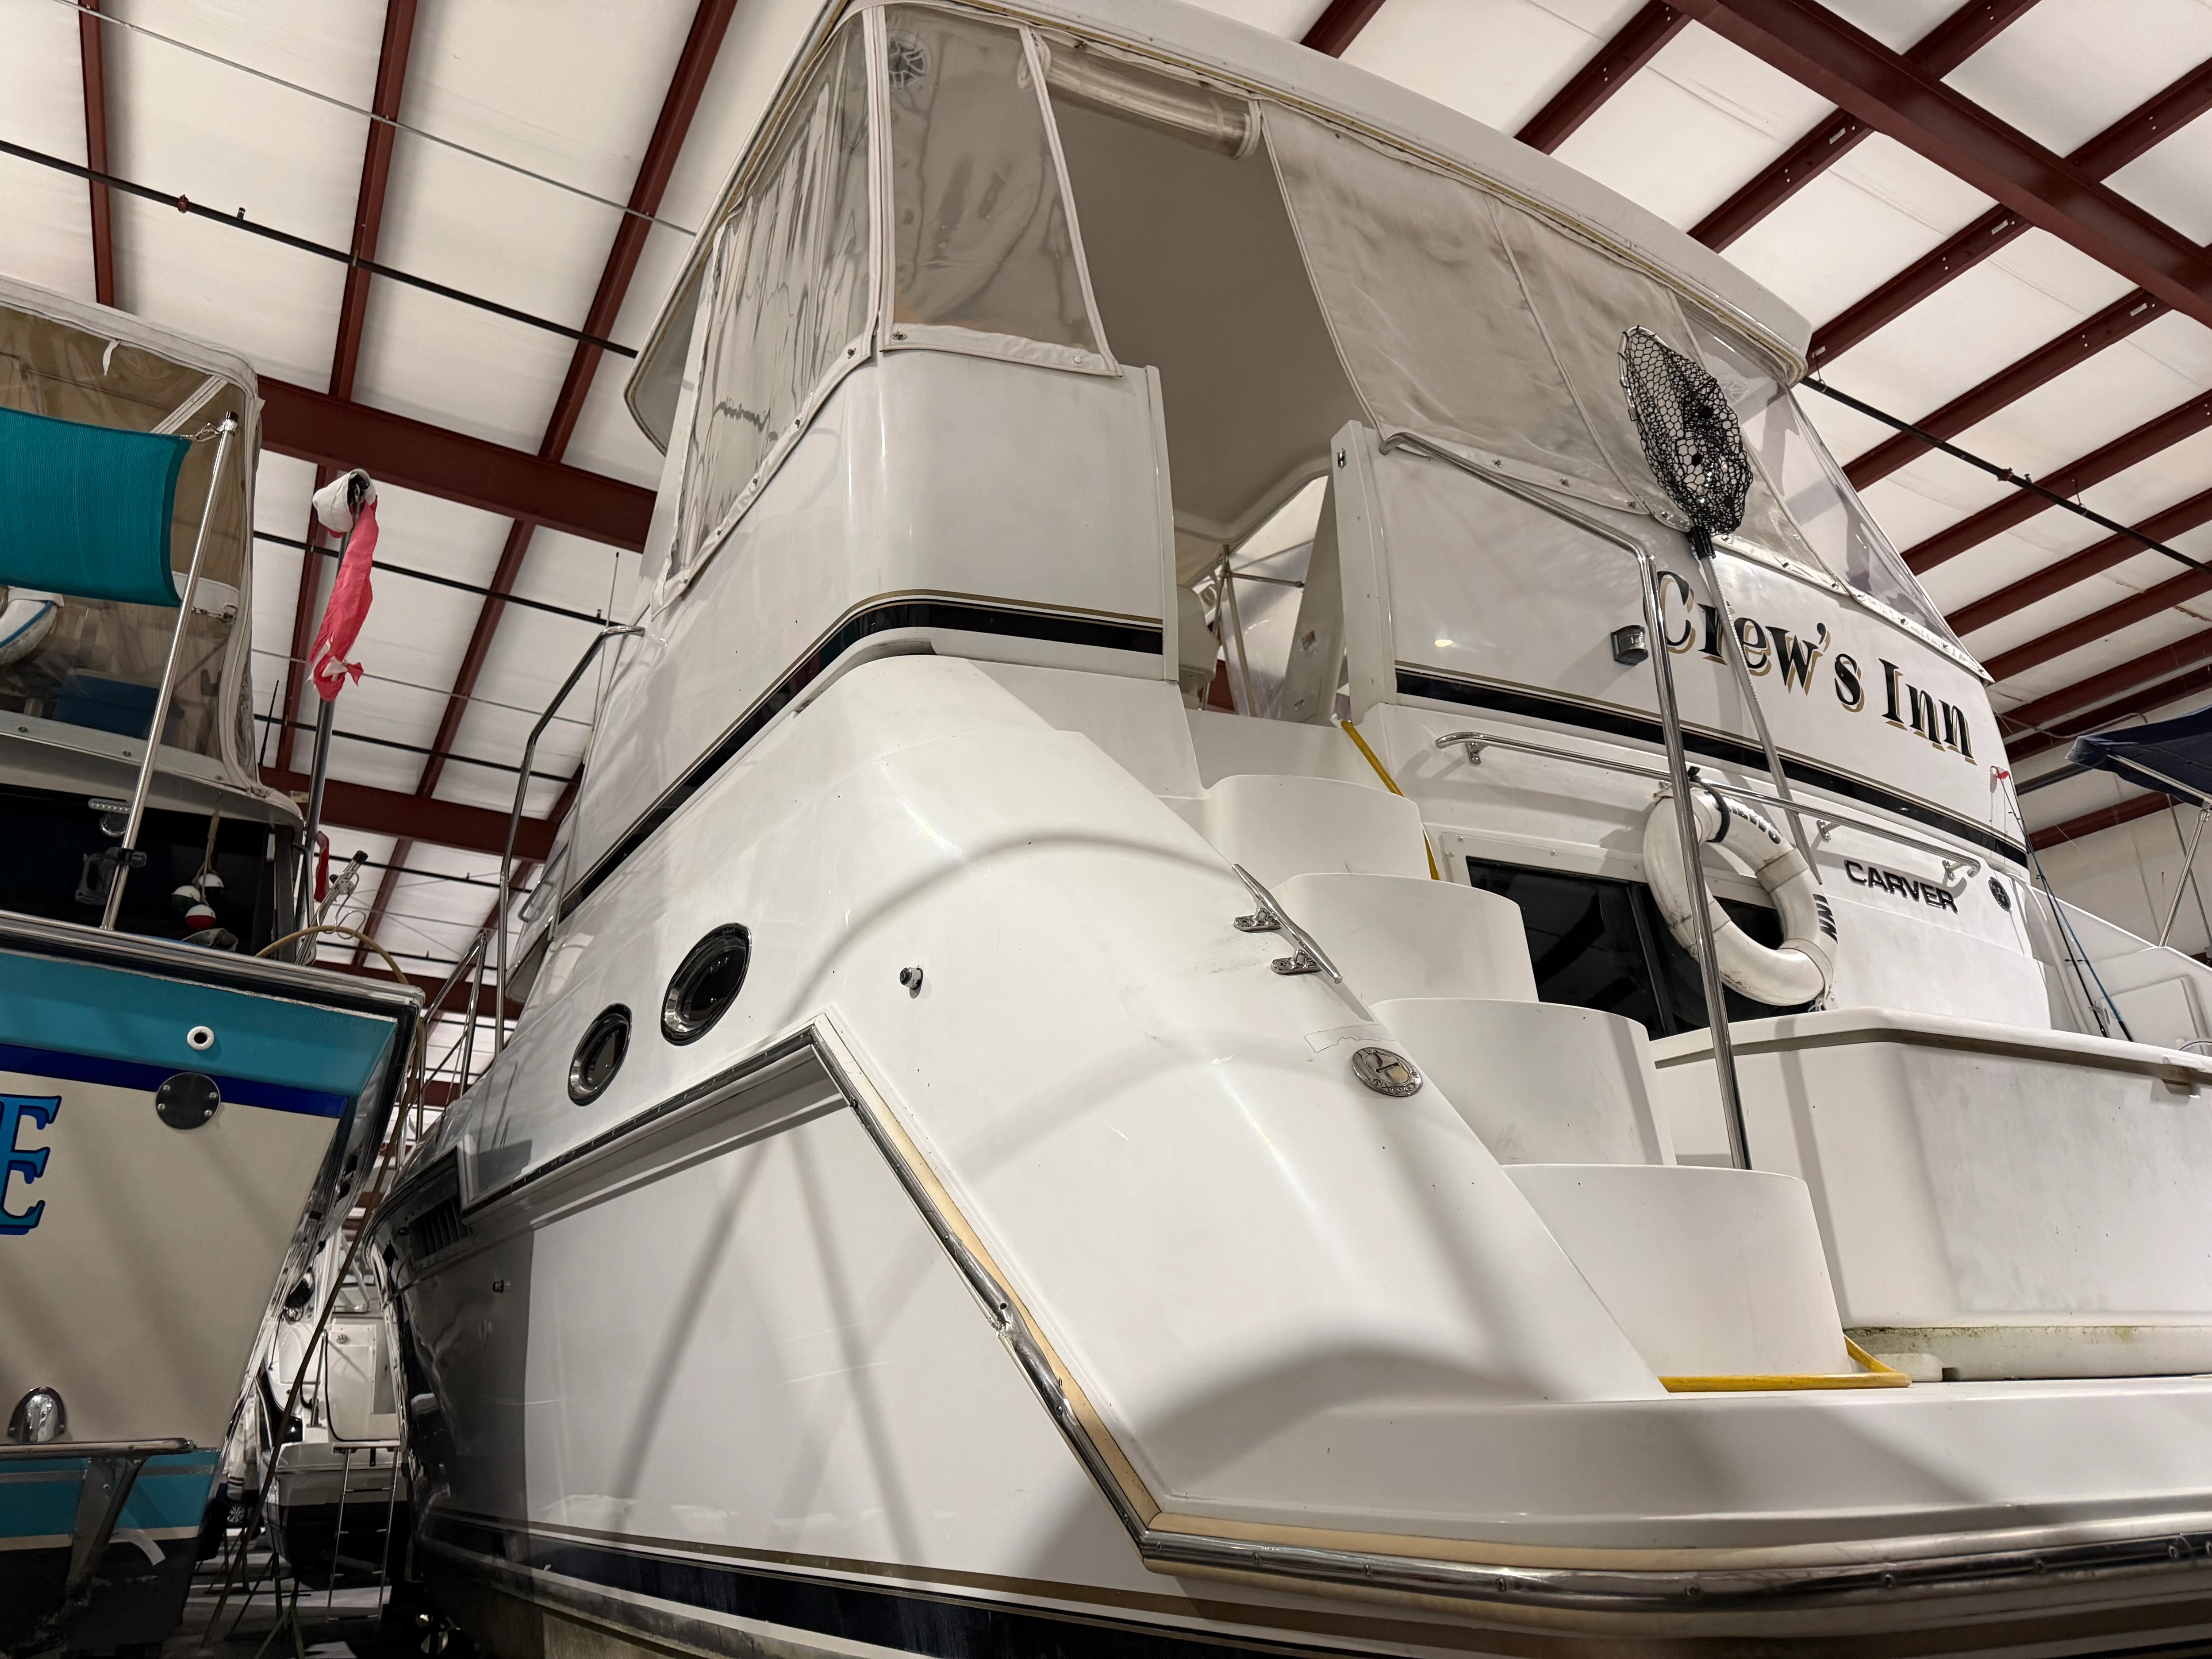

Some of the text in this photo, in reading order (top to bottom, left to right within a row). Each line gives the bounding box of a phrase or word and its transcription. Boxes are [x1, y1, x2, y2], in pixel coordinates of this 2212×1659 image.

[1643, 571, 1977, 765] Crew's Inn
[1844, 860, 1959, 914] CARVER
